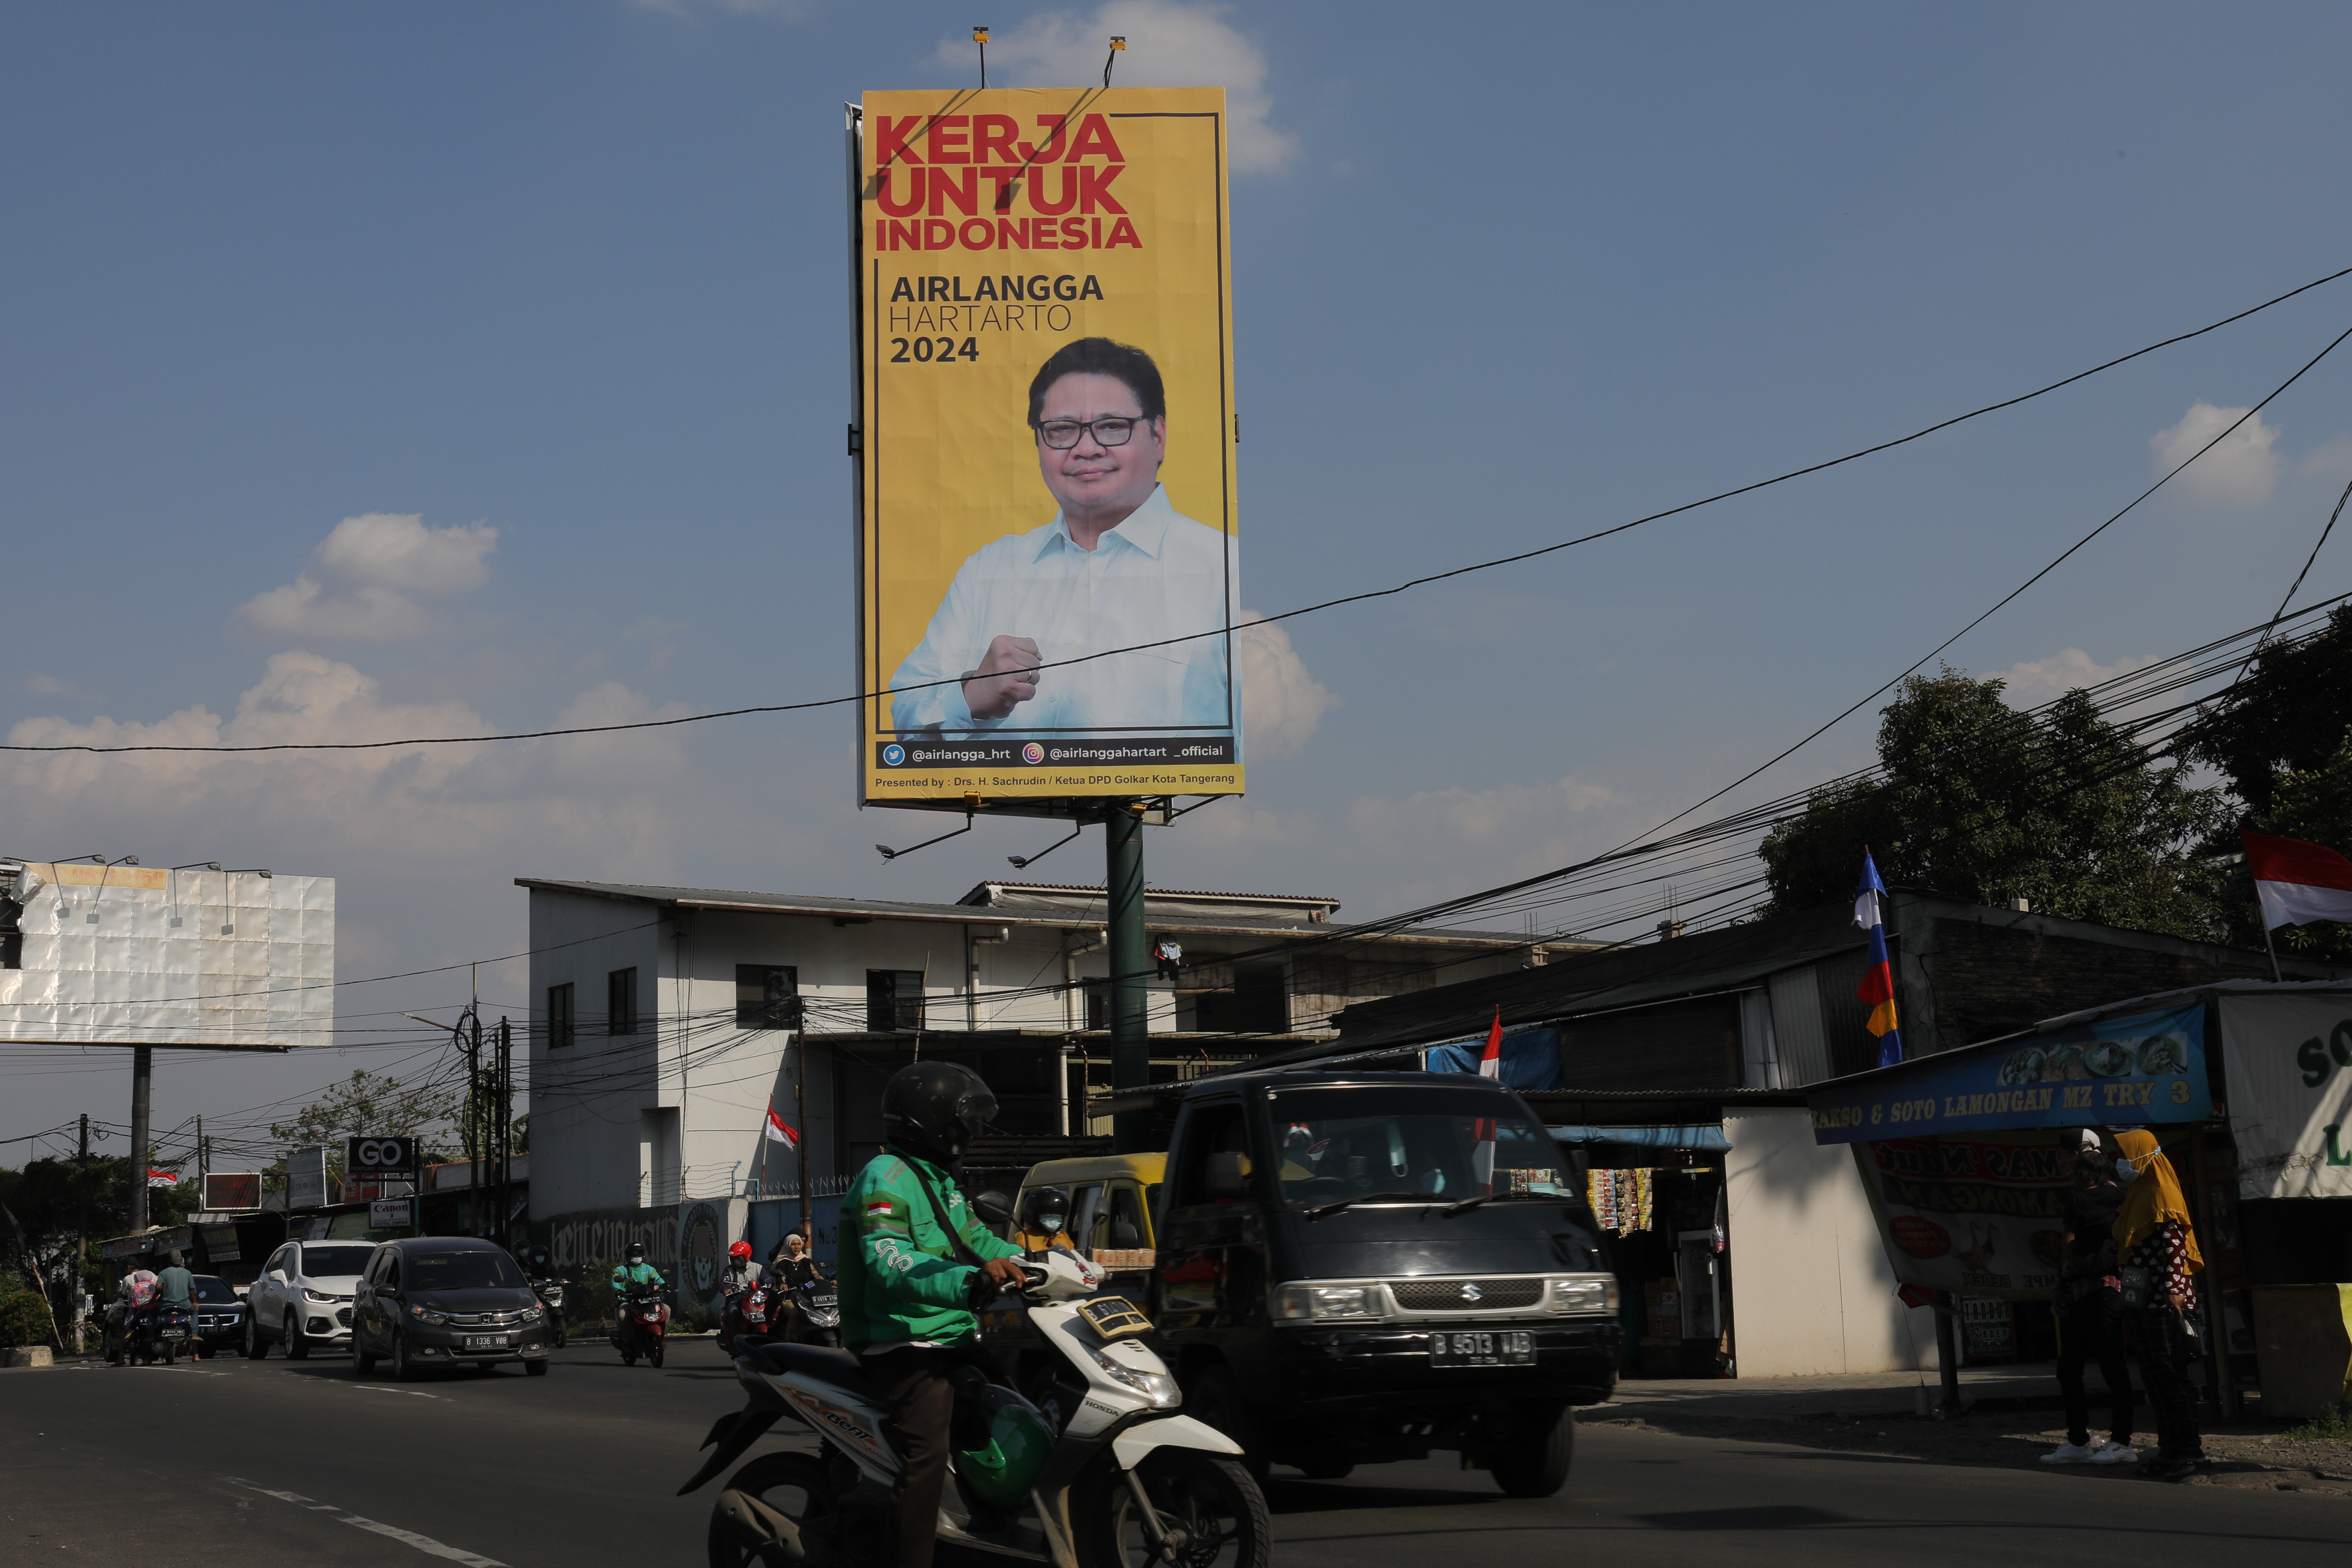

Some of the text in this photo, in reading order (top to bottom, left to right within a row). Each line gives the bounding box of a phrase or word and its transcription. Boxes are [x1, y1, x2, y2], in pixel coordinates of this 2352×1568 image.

[876, 113, 1125, 164] KERJA
[876, 165, 1128, 216] UNTUK
[876, 217, 1143, 251] INDONESIA
[890, 275, 1104, 302] AIRLANGGA
[890, 304, 1071, 332] HARTARTO
[890, 337, 979, 362] 2024
[913, 748, 1010, 761] @airlangga_hrt
[876, 778, 928, 787] Presented
[931, 778, 944, 788] by
[954, 777, 976, 786] Drs.
[979, 777, 989, 786] H.
[993, 775, 1046, 786] Sachrudin
[1055, 775, 1085, 785] Ketua
[1089, 775, 1111, 784] DPD
[1115, 774, 1149, 784] Golkar
[1152, 774, 1176, 783] Kota
[1179, 773, 1235, 785] Tangerang
[1871, 1104, 1883, 1124] &
[1890, 1098, 1936, 1123] SOTO
[1943, 1087, 2053, 1118] LAMONGAN
[2062, 1085, 2094, 1109] MZ
[2103, 1081, 2156, 1106] TRY
[2170, 1080, 2191, 1105] 3
[358, 1140, 402, 1165] GO
[1434, 1334, 1446, 1355] B
[1453, 1334, 1493, 1354] 9513
[1085, 1400, 1120, 1417] HONDA
